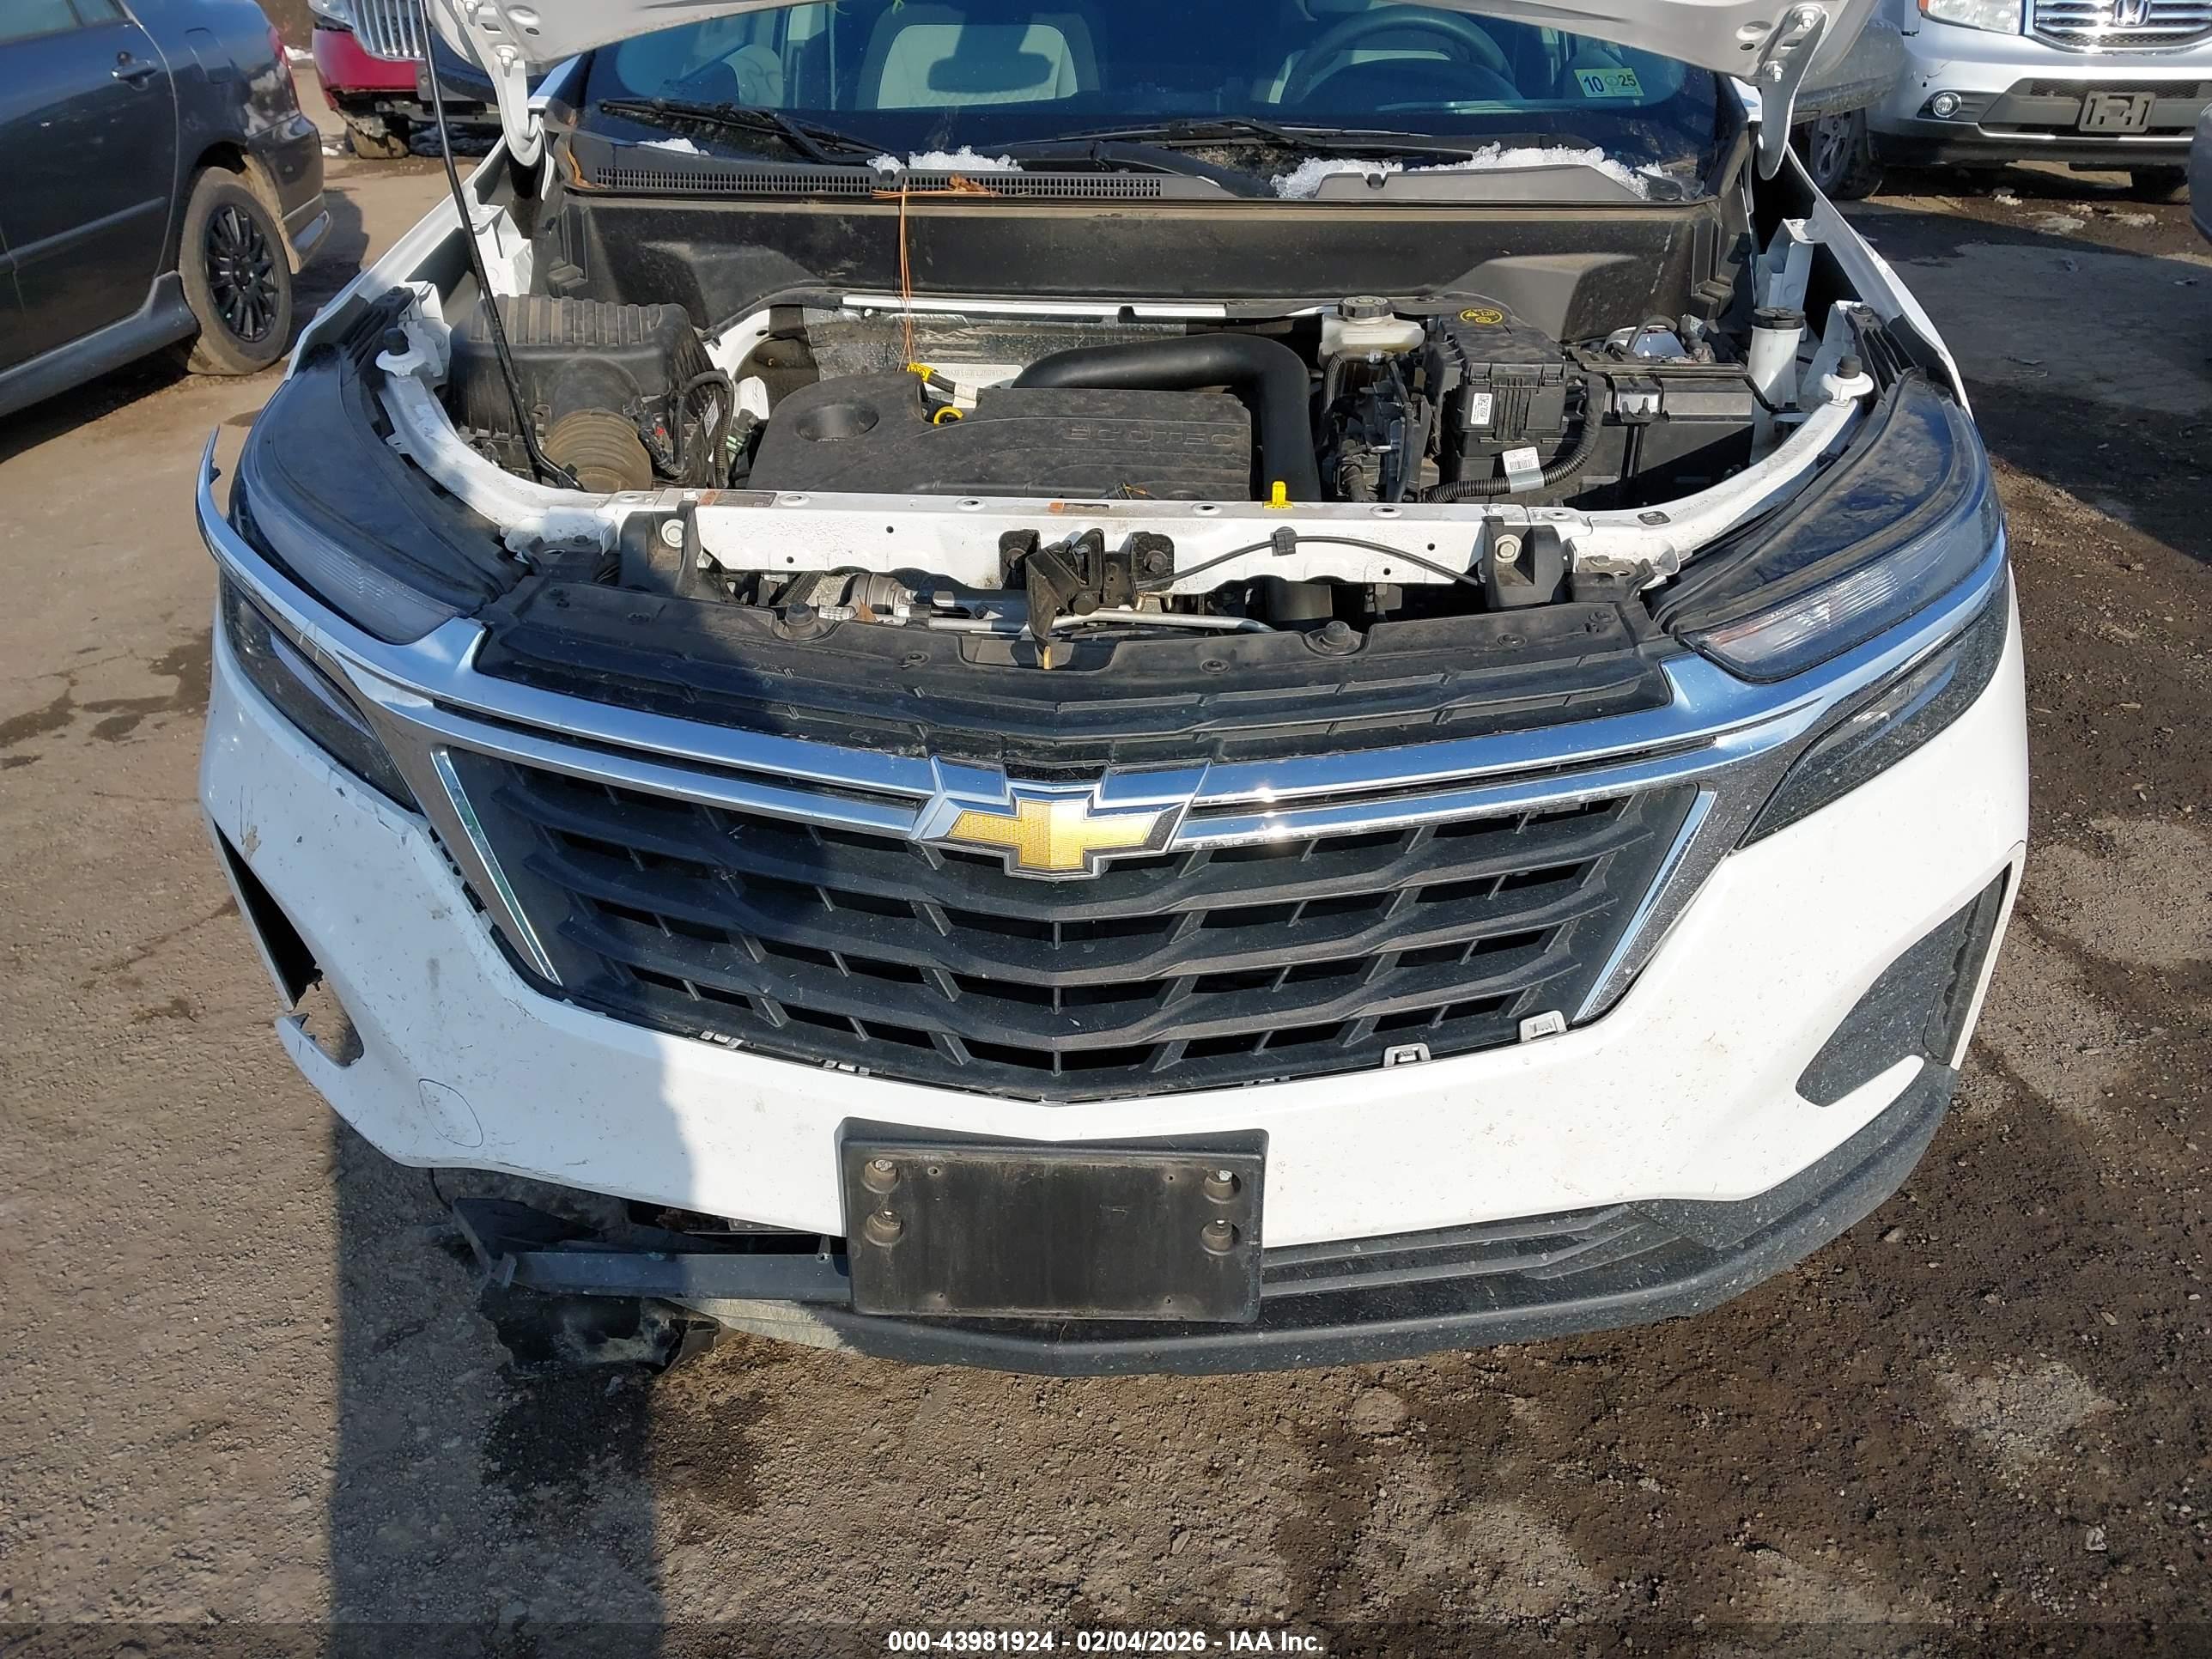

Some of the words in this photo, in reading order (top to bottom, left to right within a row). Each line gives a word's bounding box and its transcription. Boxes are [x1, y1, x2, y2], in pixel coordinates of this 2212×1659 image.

[1583, 76, 1605, 93] 10
[1618, 74, 1637, 87] 25
[1063, 426, 1237, 447] ECOTEC
